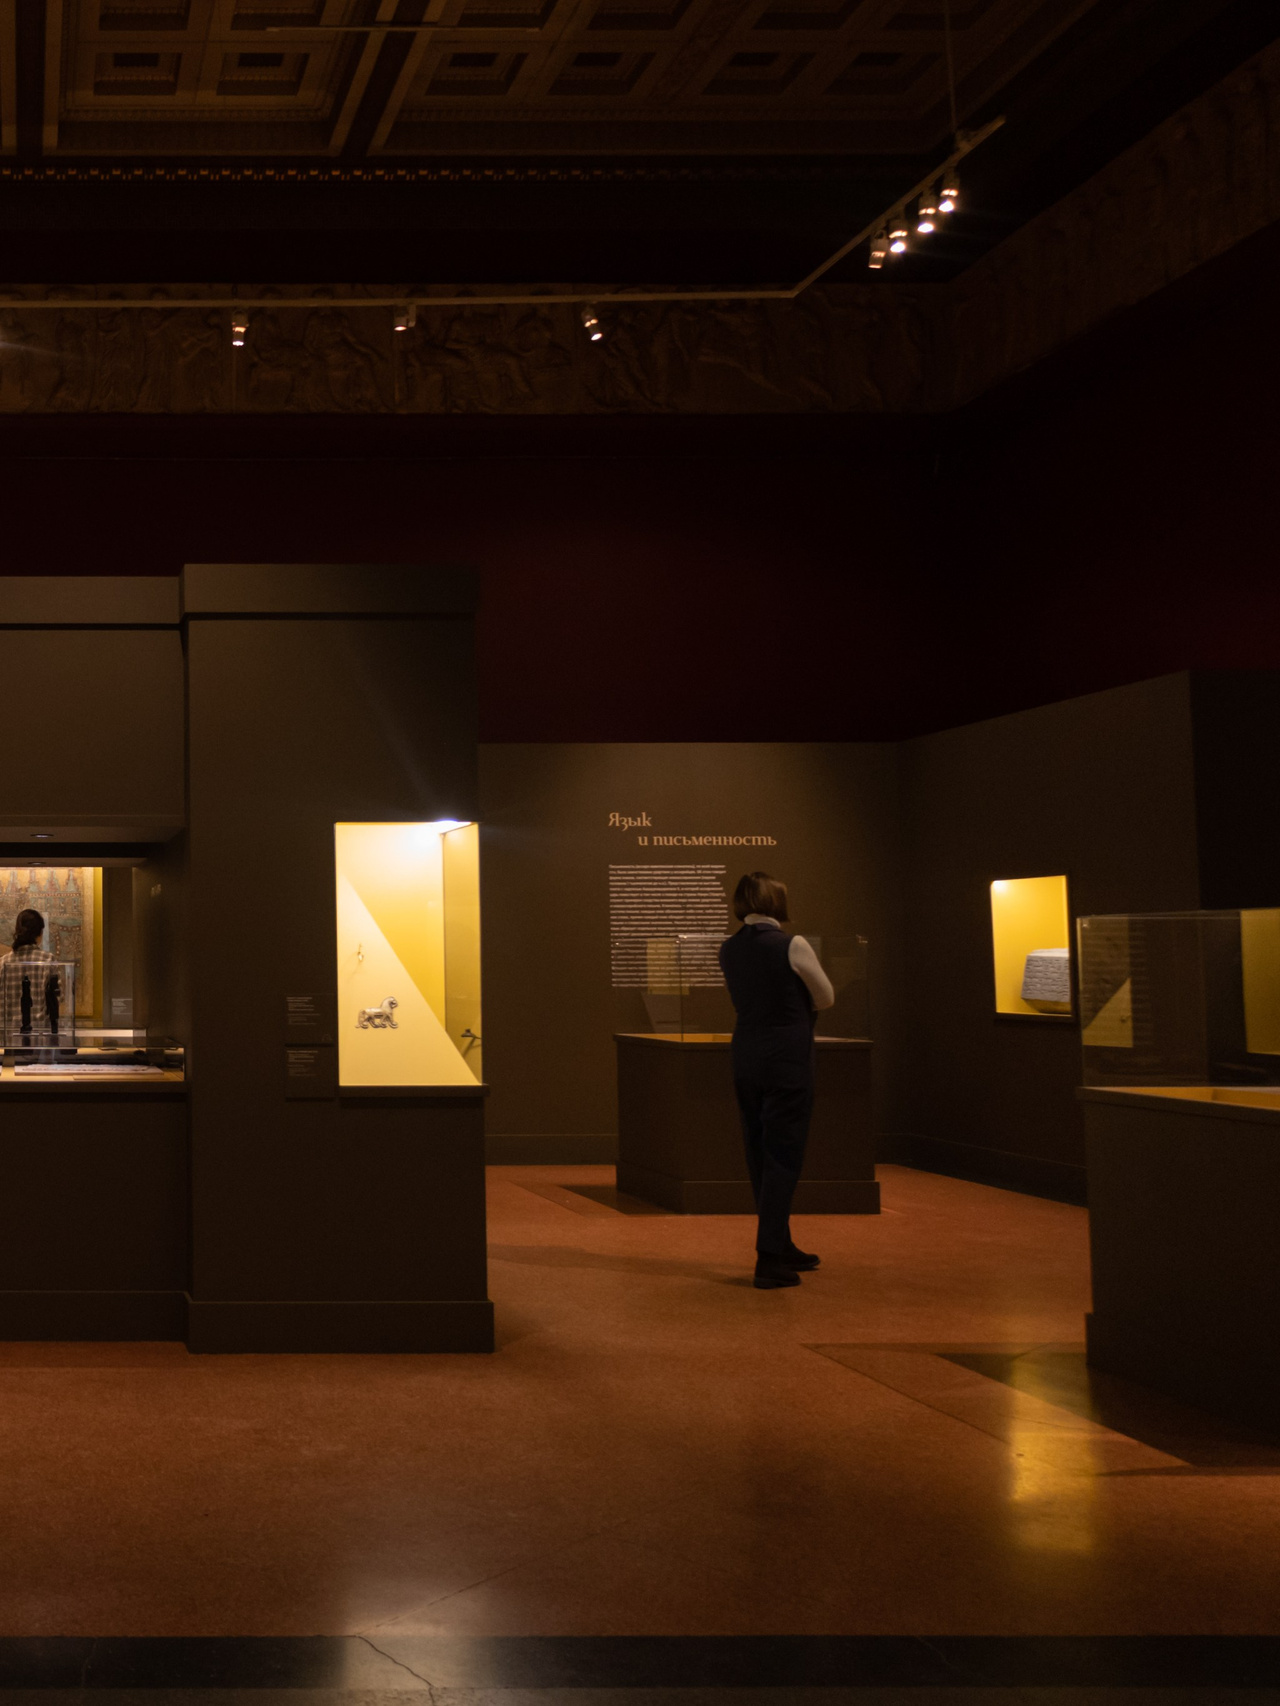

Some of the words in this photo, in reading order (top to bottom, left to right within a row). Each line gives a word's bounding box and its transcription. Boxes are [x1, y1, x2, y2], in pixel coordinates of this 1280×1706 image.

[608, 812, 652, 831] Язык
[638, 836, 649, 846] и
[653, 836, 777, 846] письменность
